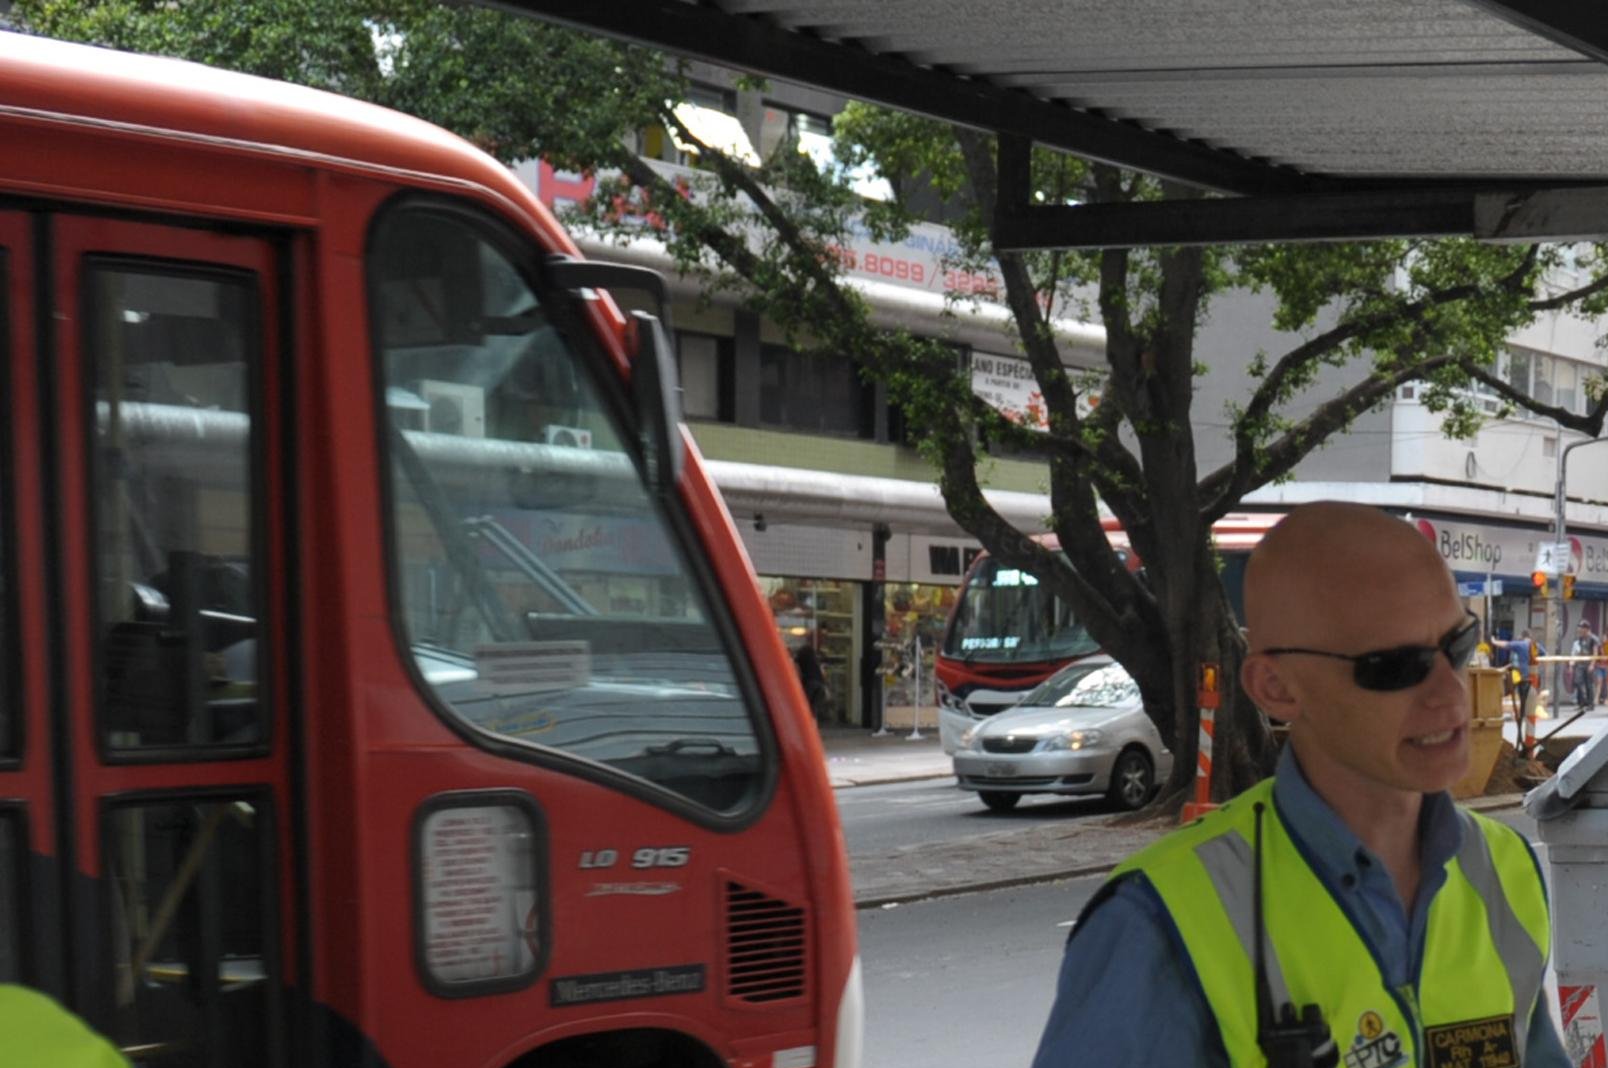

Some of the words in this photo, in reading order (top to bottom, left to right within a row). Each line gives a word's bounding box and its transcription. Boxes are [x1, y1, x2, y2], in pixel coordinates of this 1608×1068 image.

[1441, 530, 1501, 570] BelShop
[631, 847, 692, 869] 915
[555, 970, 701, 1003] Mercedes-Benz
[1435, 1023, 1507, 1048] CARMONA
